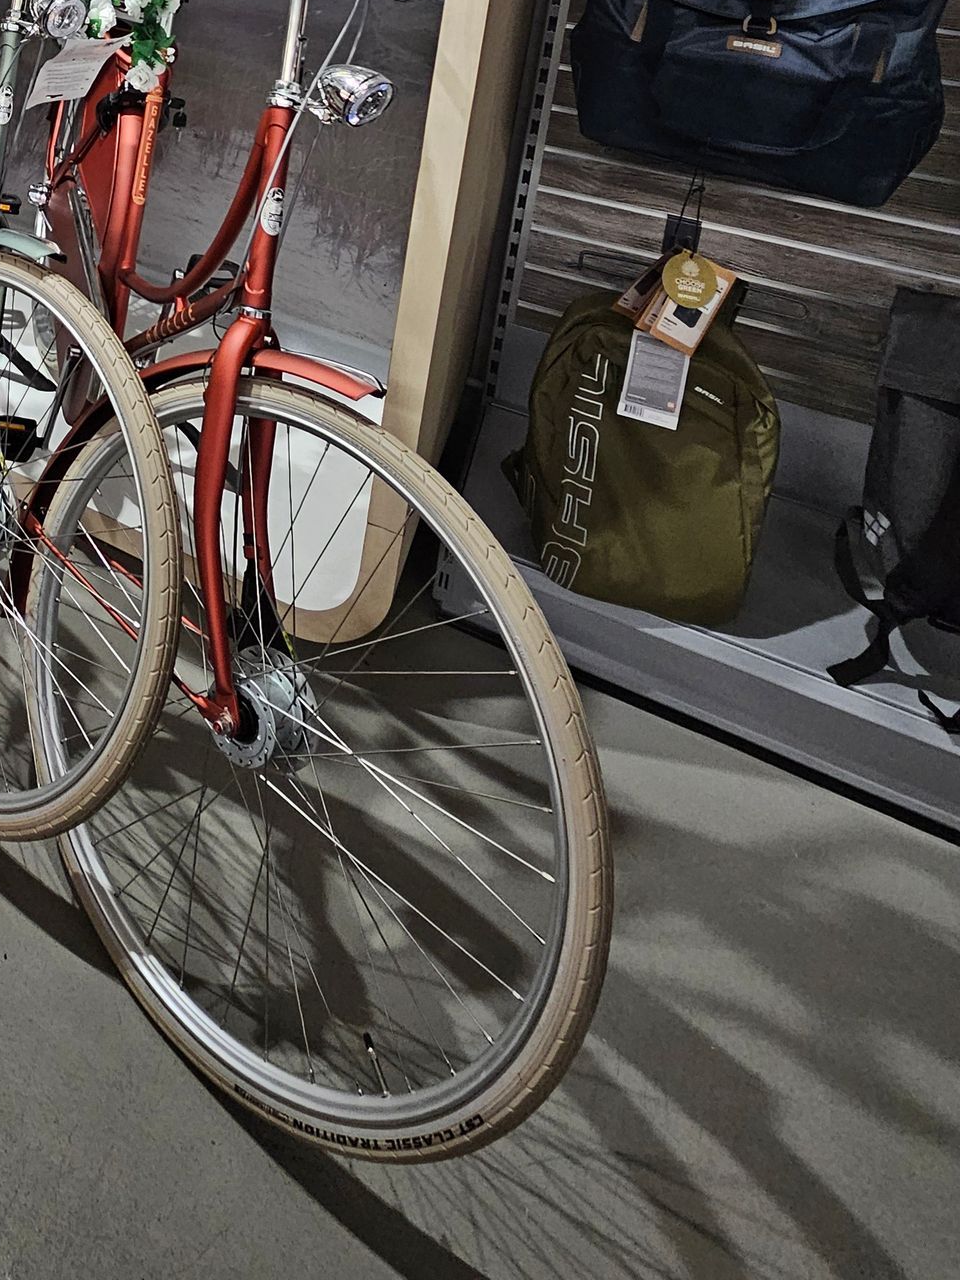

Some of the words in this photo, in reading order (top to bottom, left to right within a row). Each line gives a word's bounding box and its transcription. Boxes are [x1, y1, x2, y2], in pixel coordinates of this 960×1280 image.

[138, 105, 158, 192] GAZELLE
[694, 385, 724, 405] BASIL
[540, 353, 609, 590] BASIL
[292, 1118, 380, 1151] TRADITION
[458, 1113, 484, 1136] CST
[385, 1130, 456, 1151] CLASSIC
